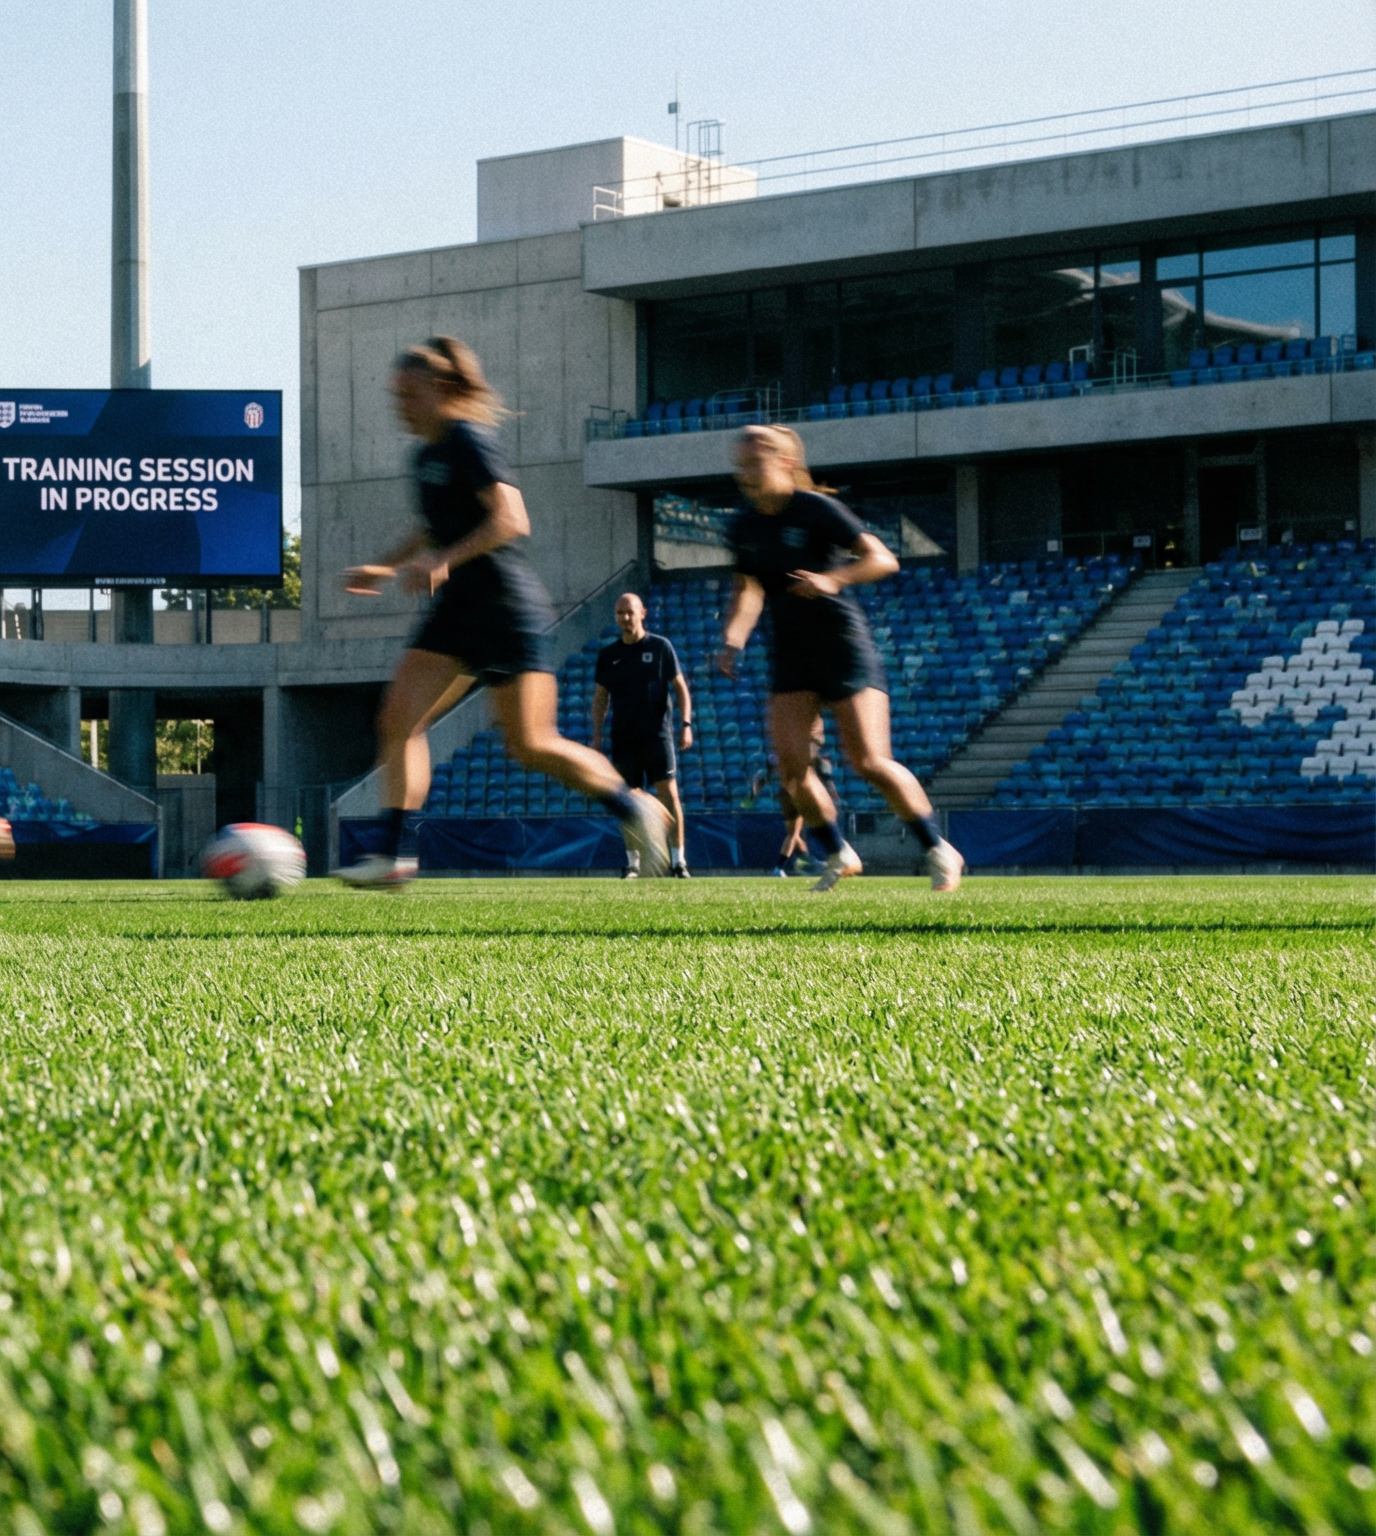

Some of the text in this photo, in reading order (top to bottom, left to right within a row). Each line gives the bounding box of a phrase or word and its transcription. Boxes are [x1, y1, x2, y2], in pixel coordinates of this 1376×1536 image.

[2, 457, 254, 483] TRAINING SESSION
[40, 487, 219, 512] IN PROGRESS
